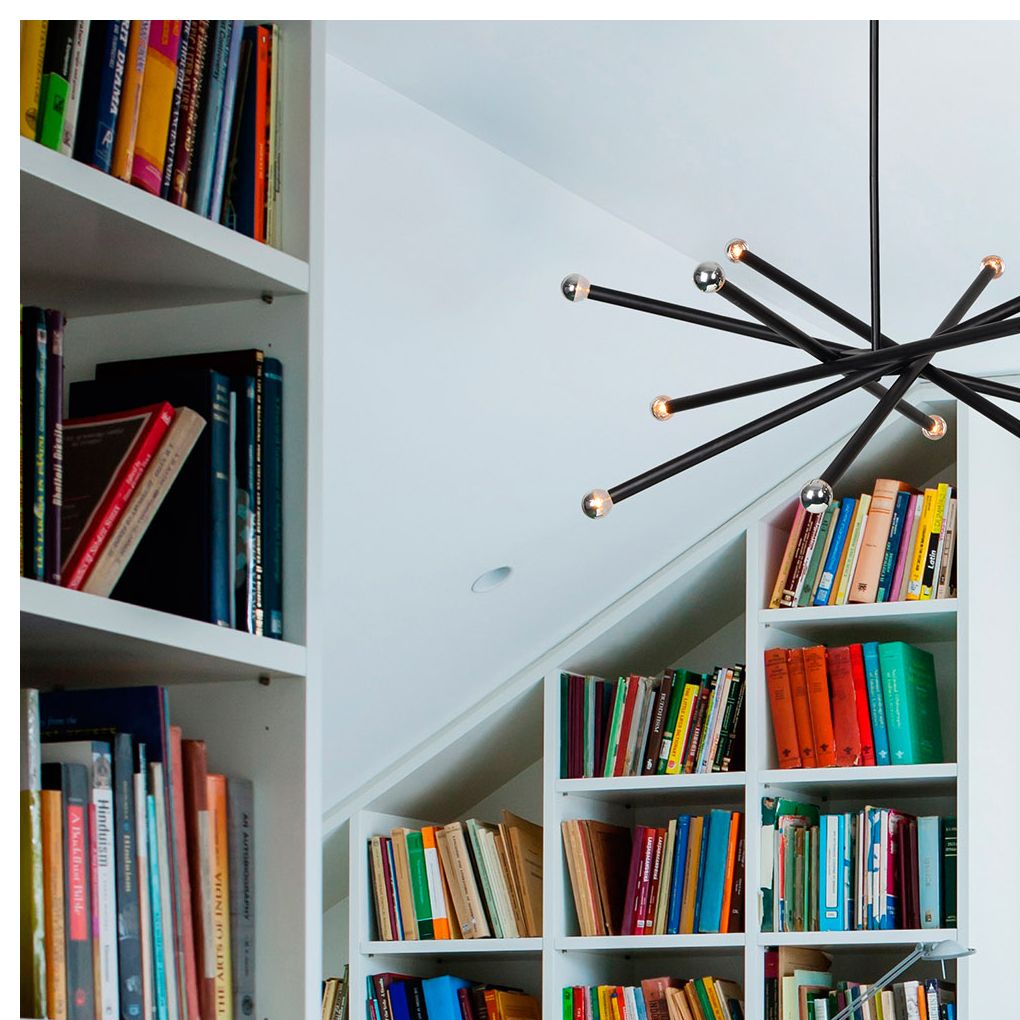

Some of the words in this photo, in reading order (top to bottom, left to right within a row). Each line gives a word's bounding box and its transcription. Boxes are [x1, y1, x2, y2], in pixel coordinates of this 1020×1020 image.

[109, 49, 126, 115] DRAMA
[175, 40, 189, 93] THOUGHT
[173, 93, 182, 105] IN
[167, 109, 180, 156] ANCIENT
[182, 127, 193, 152] AND
[163, 156, 174, 186] INDIA
[925, 548, 938, 569] Latin
[70, 812, 80, 823] A
[97, 798, 110, 867] Hinduism
[242, 812, 250, 828] AN
[70, 825, 84, 881] Buddhist
[242, 831, 250, 920] AUTOBIOGRAPHY
[72, 884, 85, 915] Bible
[214, 872, 223, 916] INDIA
[215, 921, 223, 940] OF
[215, 943, 225, 981] ARTS
[217, 986, 225, 1014] THE
